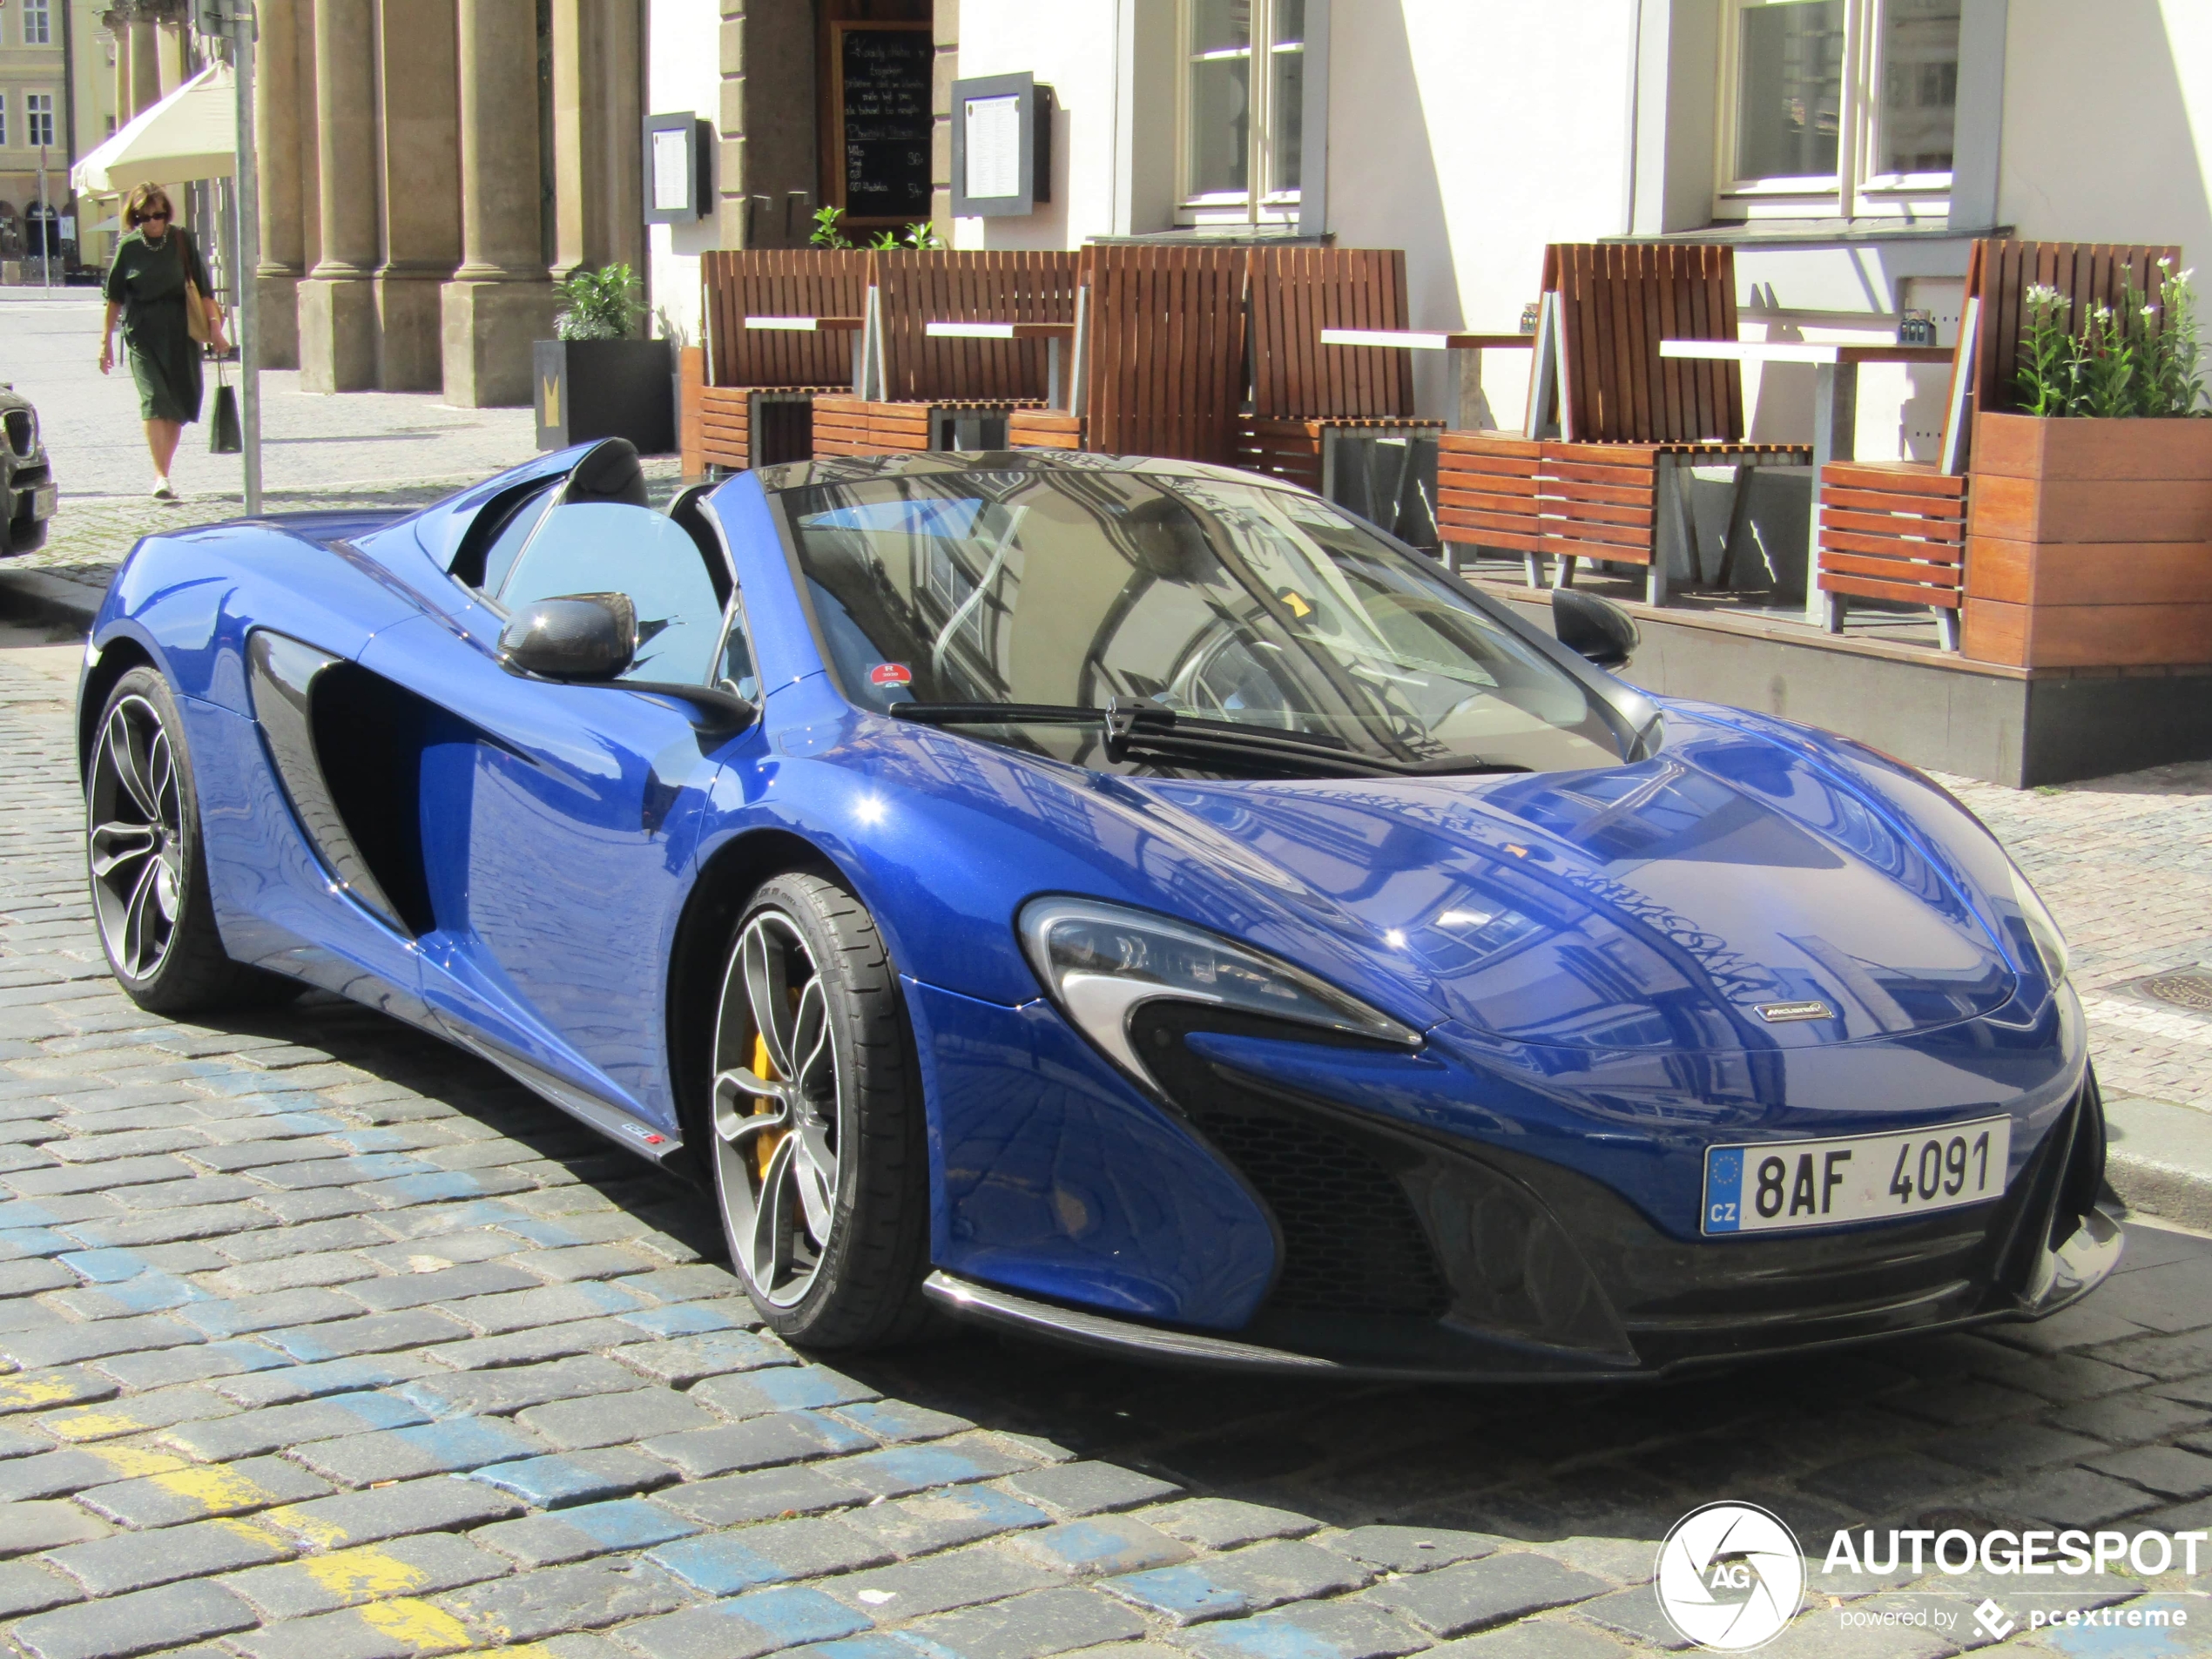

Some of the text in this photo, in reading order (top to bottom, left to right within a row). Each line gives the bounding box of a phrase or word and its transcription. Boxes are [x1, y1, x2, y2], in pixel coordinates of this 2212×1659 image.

[1766, 1005, 1820, 1016] McLaren
[1755, 1130, 1990, 1218] 8AF 4091
[1710, 1203, 1736, 1223] CZ
